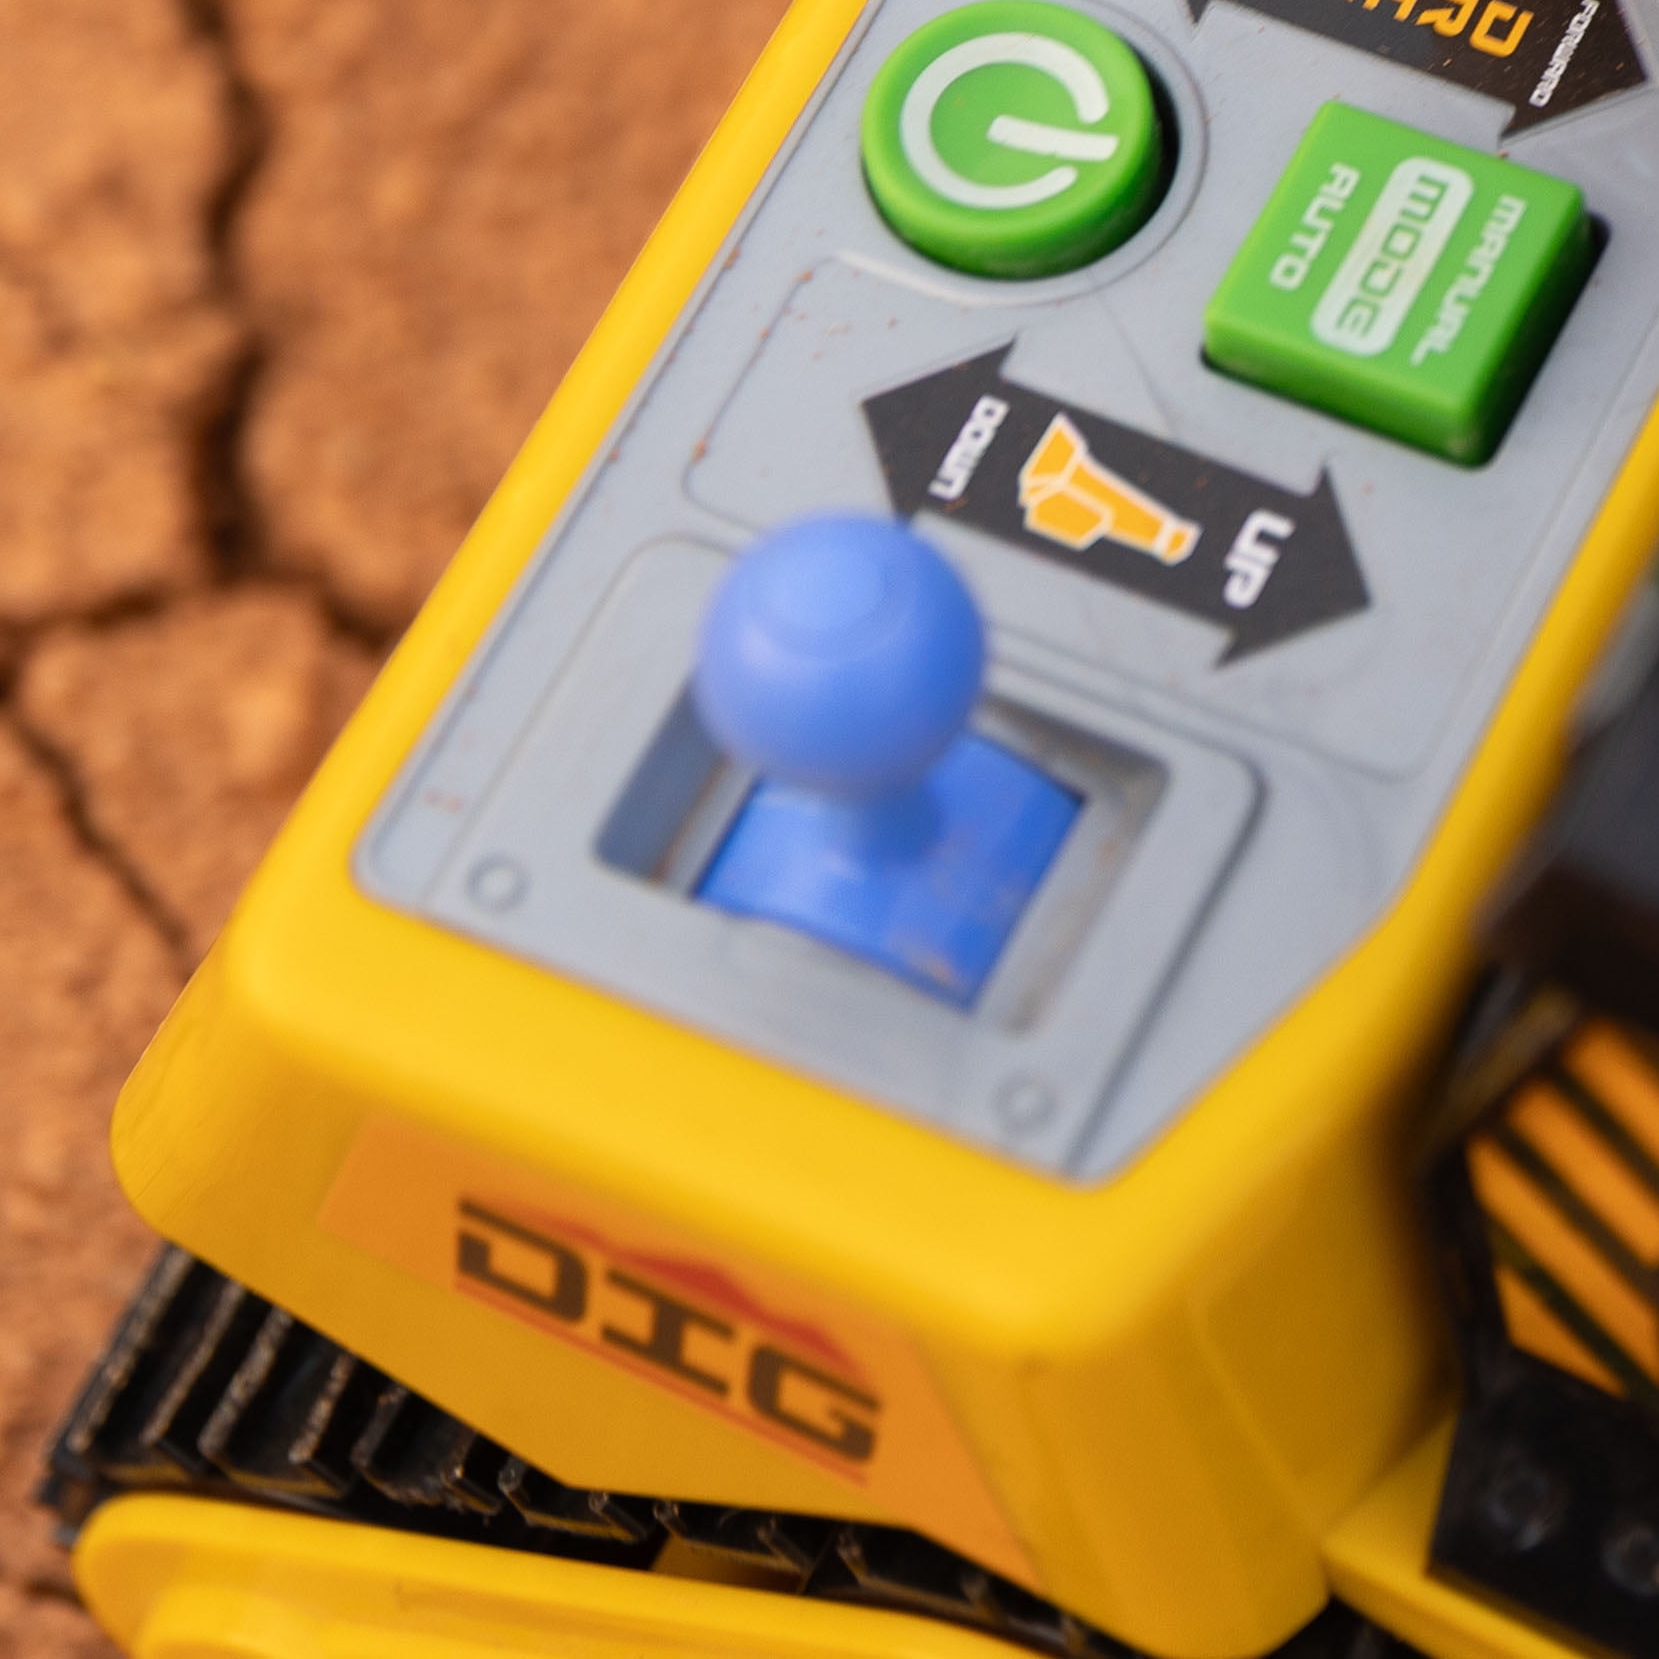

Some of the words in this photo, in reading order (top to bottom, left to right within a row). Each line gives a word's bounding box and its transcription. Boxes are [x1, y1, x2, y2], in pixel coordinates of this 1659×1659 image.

[1269, 162, 1361, 291] AUTO
[1337, 174, 1450, 338] MODE
[1410, 194, 1527, 367] MANUAL
[929, 394, 1010, 501] DOWN
[1223, 509, 1295, 609] UP
[456, 1197, 881, 1463] DIG
